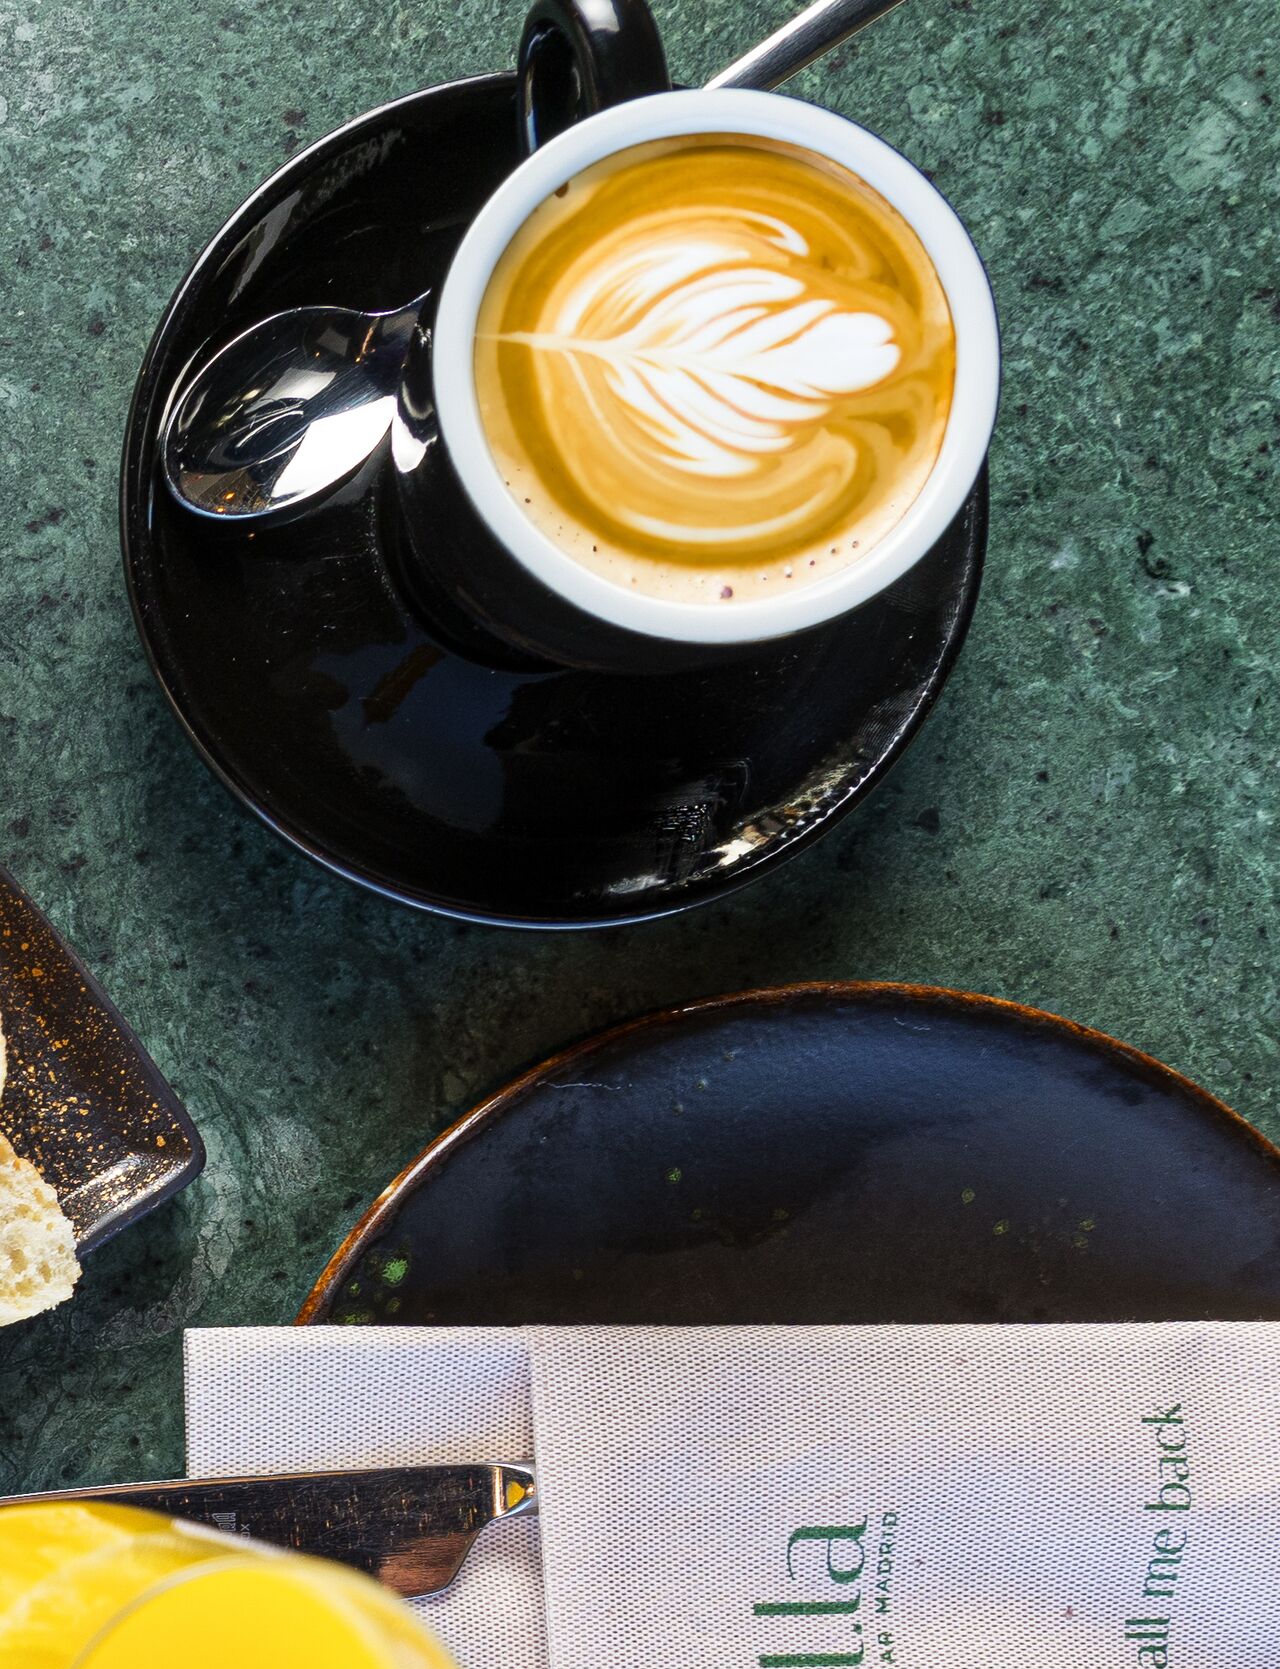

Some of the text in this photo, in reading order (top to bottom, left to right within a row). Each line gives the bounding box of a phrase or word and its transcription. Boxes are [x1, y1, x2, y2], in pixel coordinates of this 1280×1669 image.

[1141, 1402, 1191, 1511] back
[874, 1511, 900, 1614] MADRID
[1141, 1528, 1188, 1598] me
